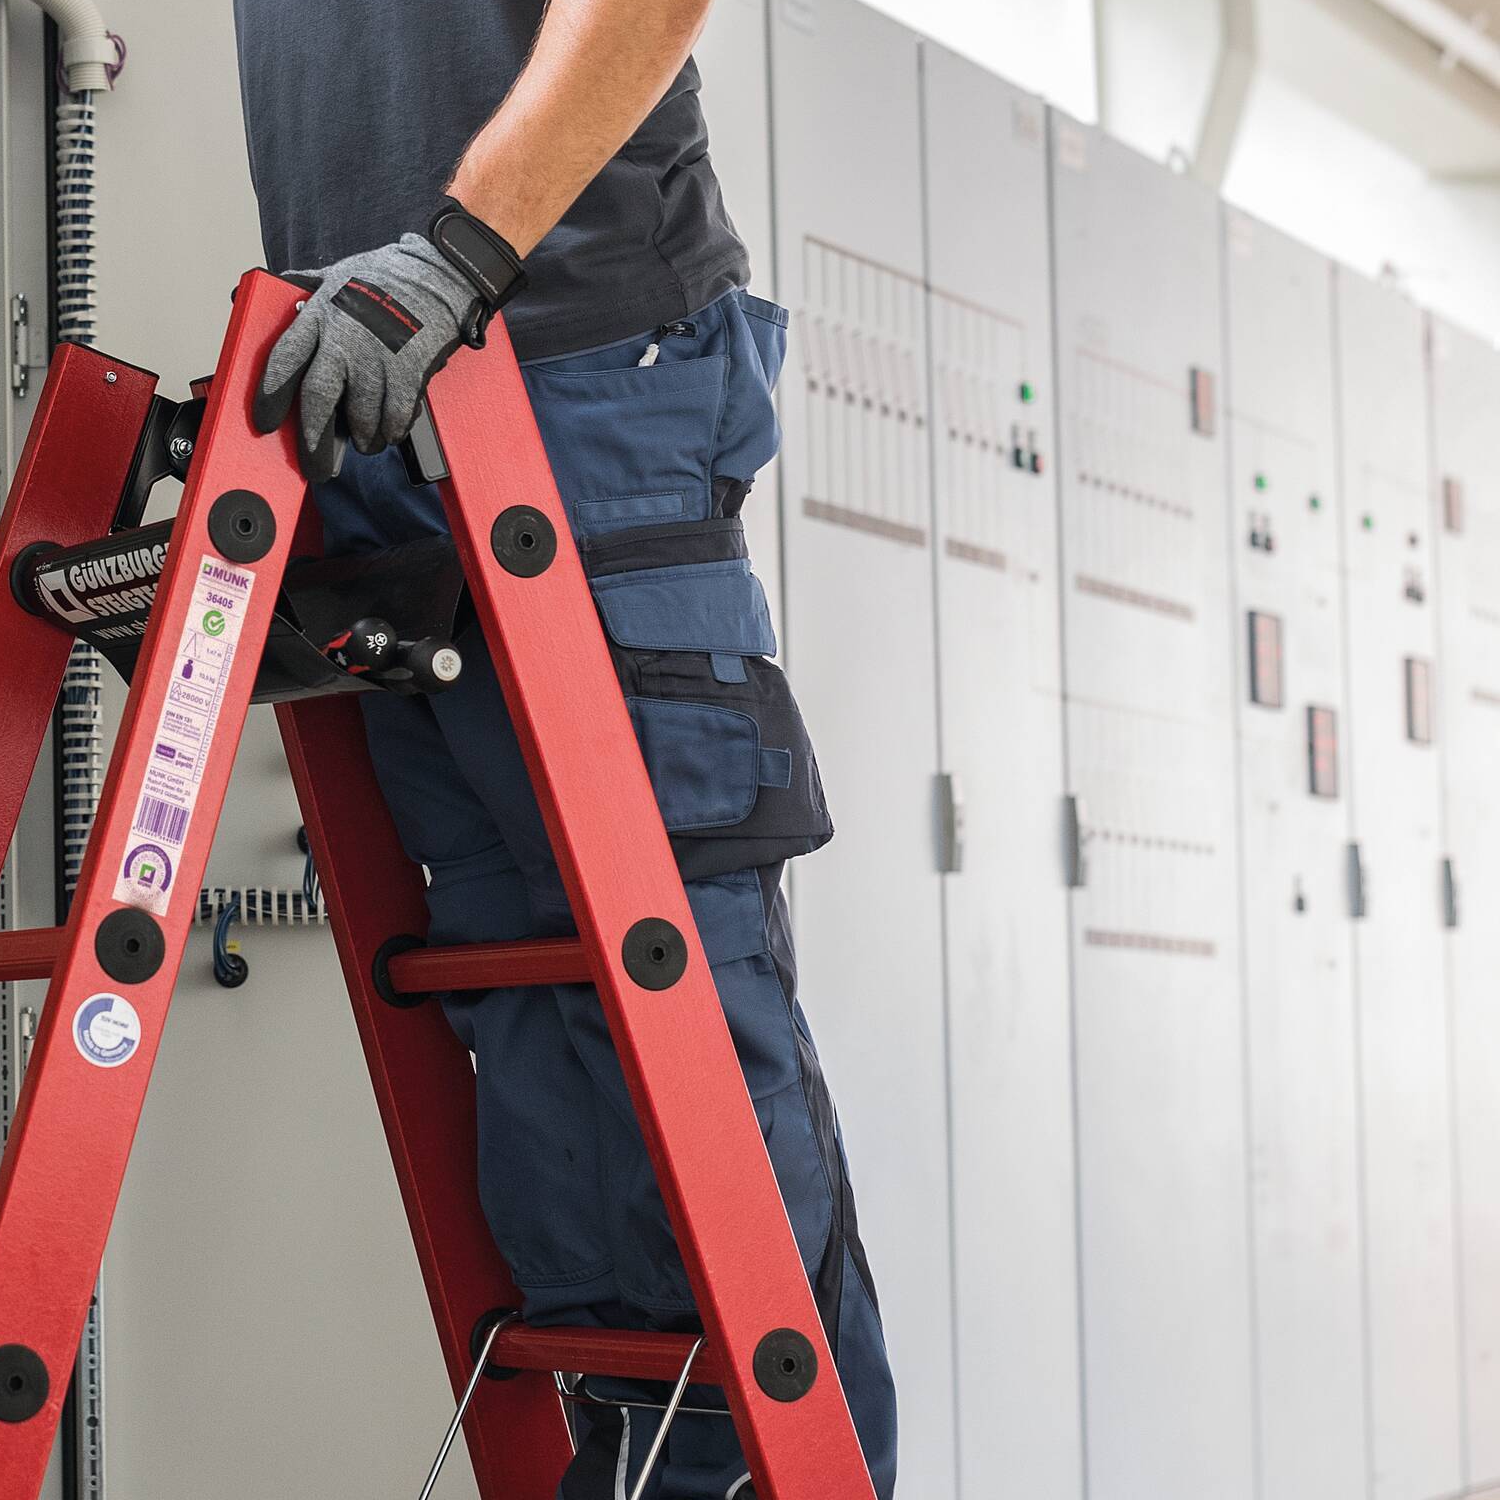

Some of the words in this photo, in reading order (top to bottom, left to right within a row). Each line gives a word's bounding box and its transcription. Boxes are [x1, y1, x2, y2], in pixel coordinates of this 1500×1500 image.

[212, 566, 249, 590] MUNK
[206, 591, 234, 610] 36405
[366, 635, 377, 649] PH
[375, 646, 382, 655] 2
[181, 691, 204, 704] 28000
